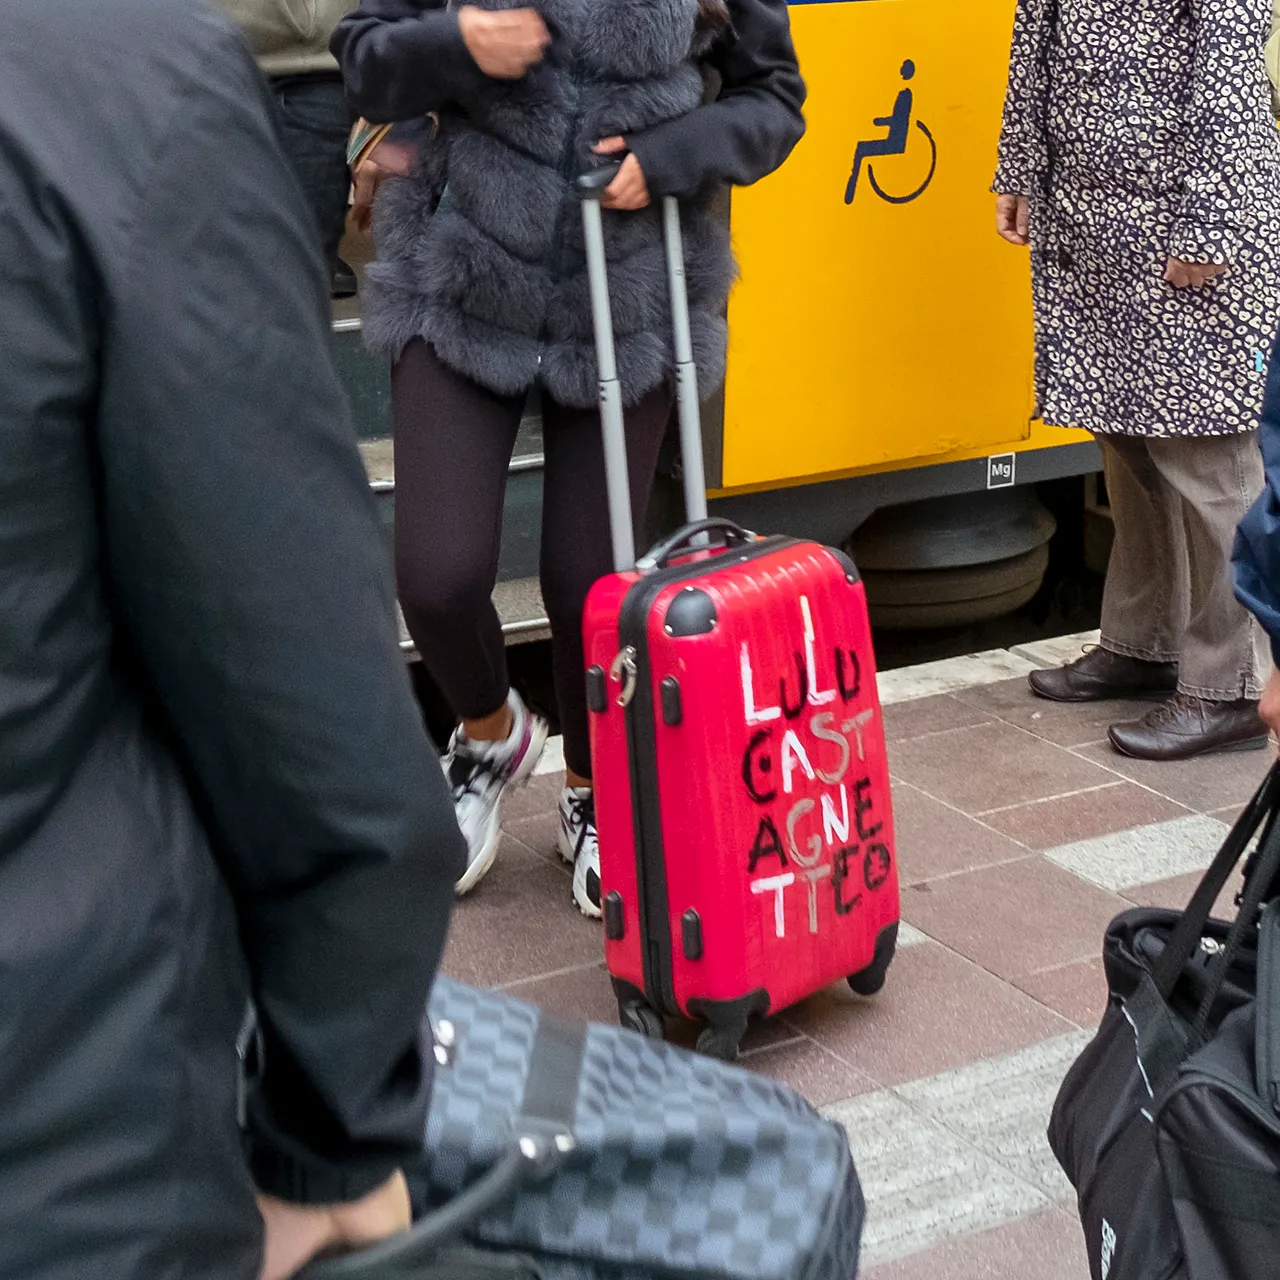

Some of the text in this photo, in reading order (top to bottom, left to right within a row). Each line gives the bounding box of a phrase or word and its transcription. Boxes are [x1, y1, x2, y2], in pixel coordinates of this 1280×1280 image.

[991, 463, 1011, 478] Mg
[740, 595, 862, 726] LULU
[742, 708, 873, 804] CAST
[747, 777, 883, 873] AGNE
